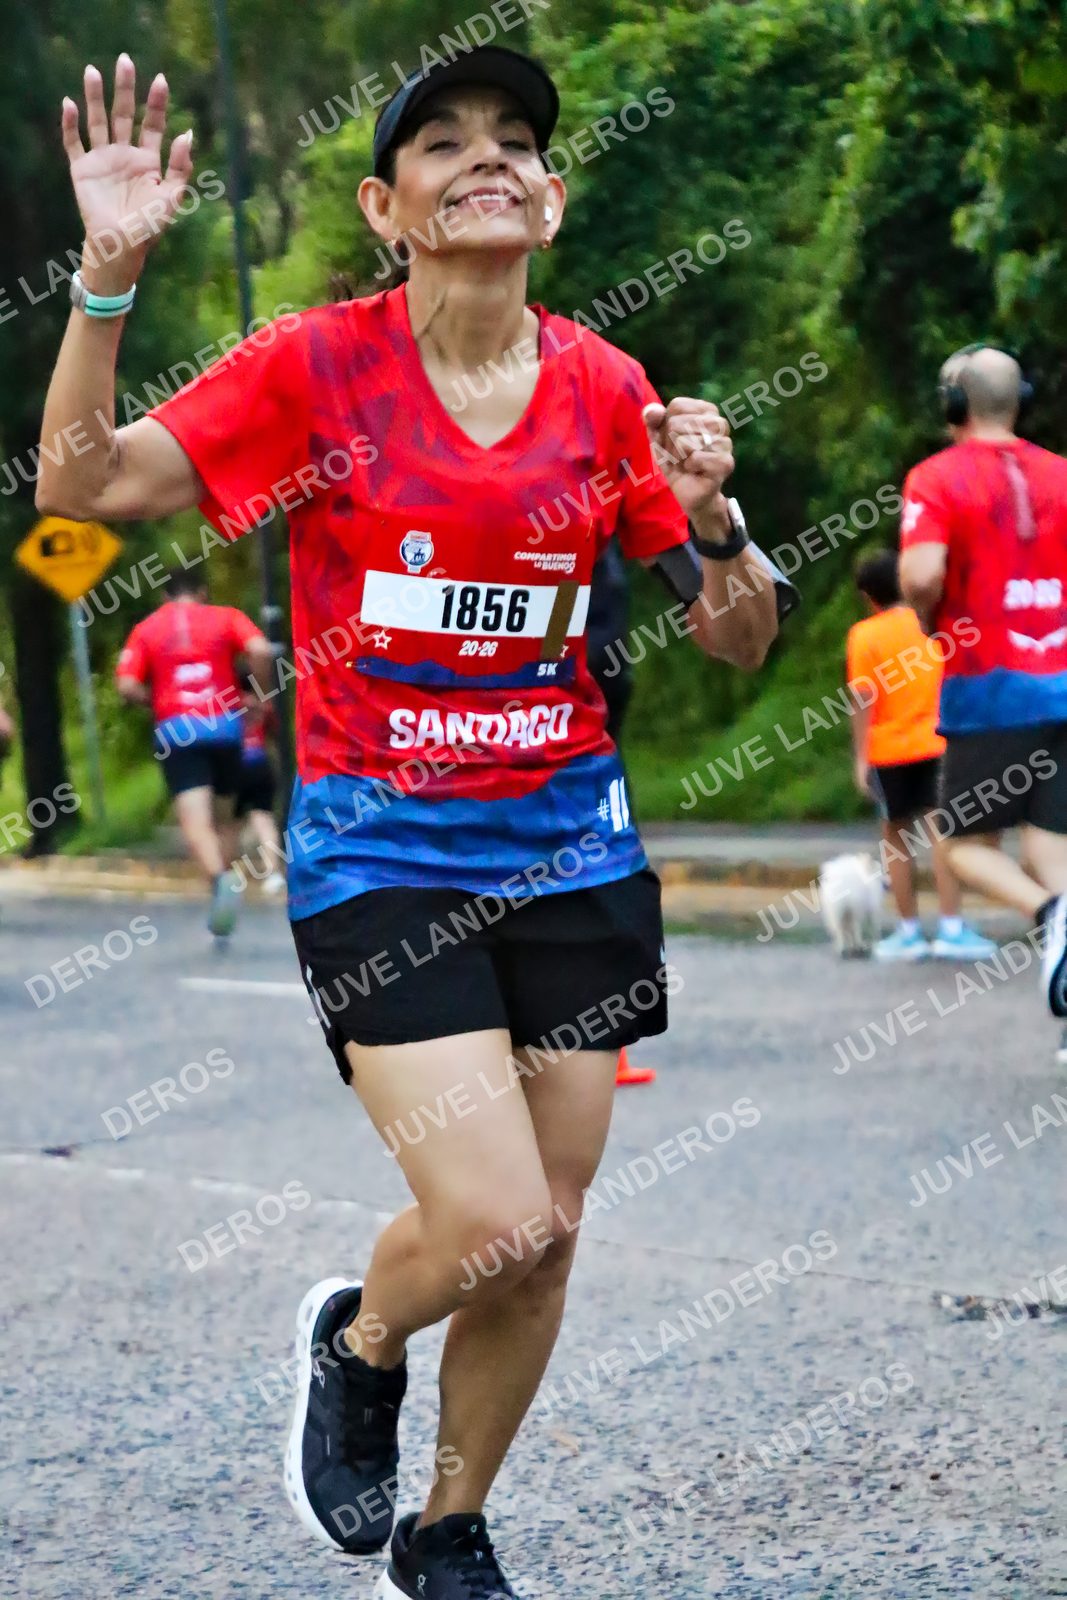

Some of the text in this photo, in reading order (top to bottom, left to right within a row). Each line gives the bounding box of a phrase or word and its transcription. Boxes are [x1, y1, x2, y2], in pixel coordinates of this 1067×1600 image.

[441, 584, 529, 632] 1856
[536, 663, 558, 677] 5K
[389, 703, 573, 748] SANTIAGO
